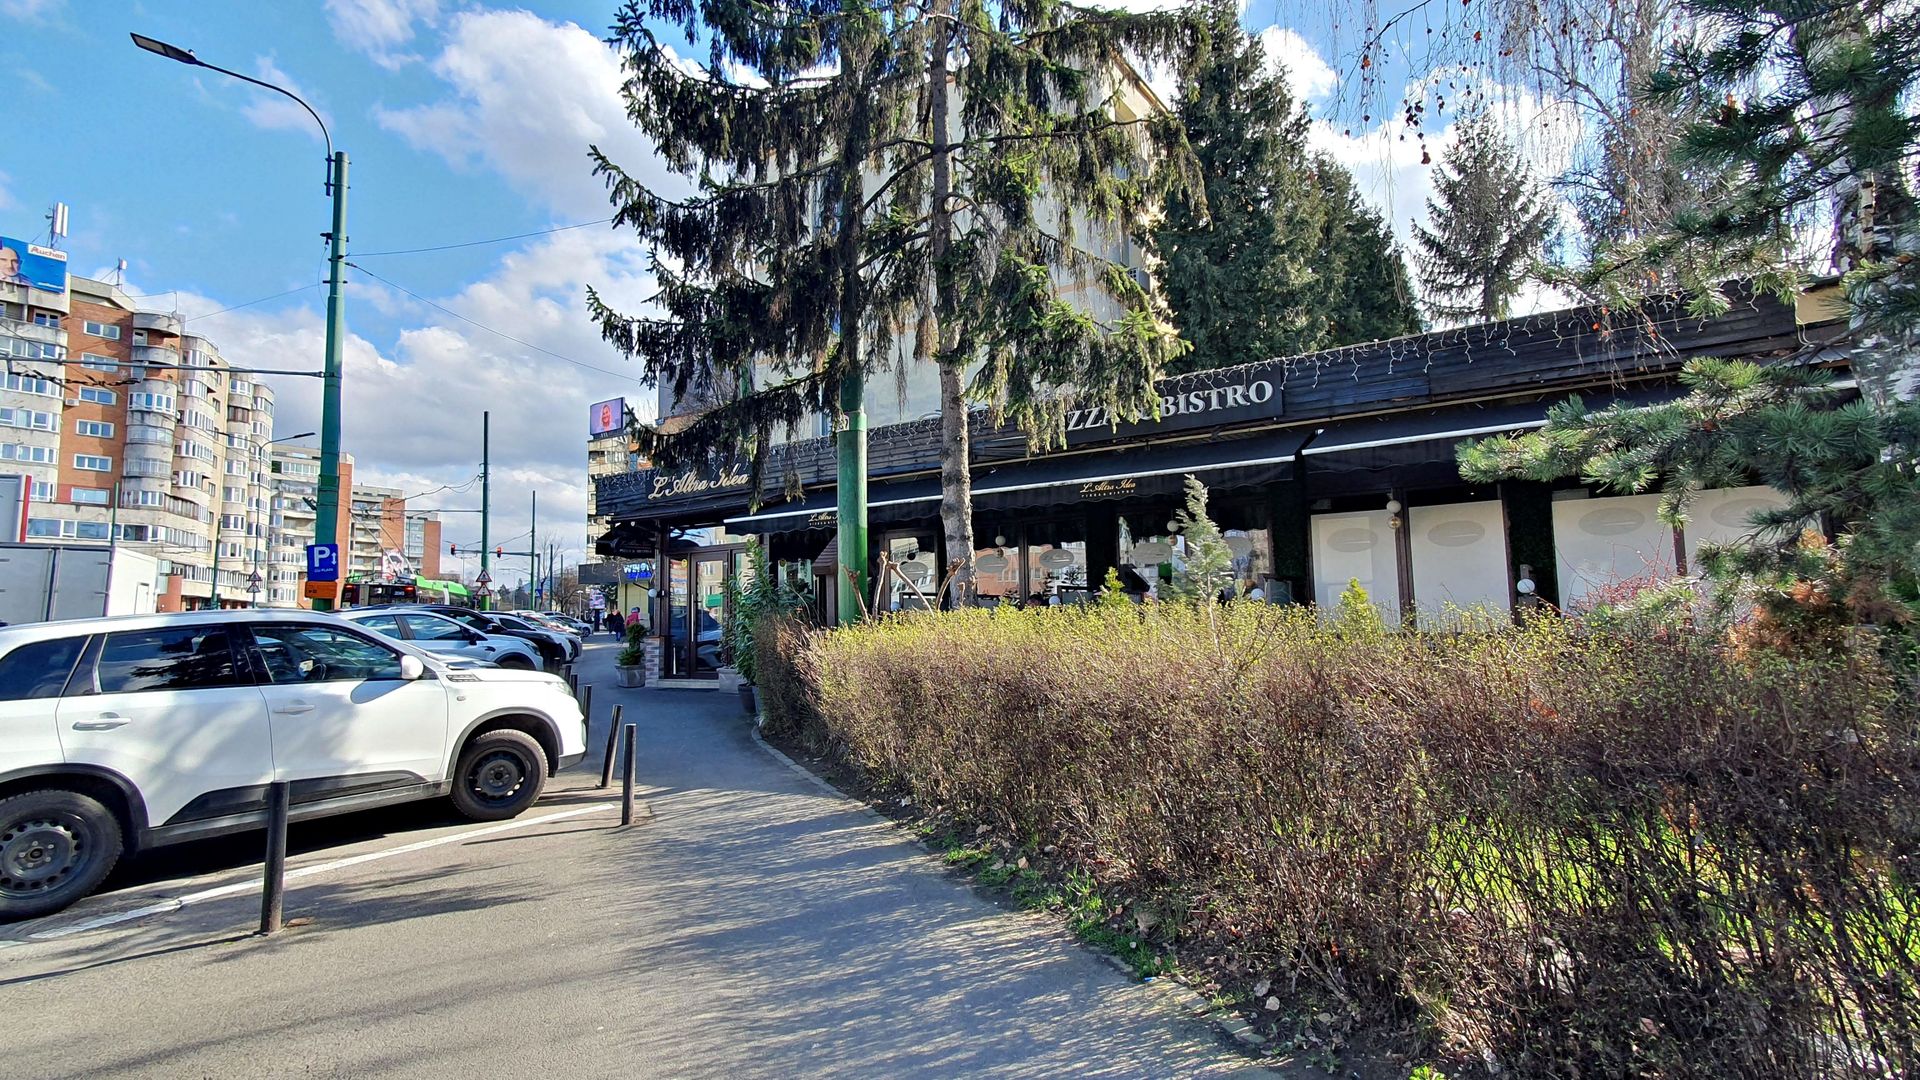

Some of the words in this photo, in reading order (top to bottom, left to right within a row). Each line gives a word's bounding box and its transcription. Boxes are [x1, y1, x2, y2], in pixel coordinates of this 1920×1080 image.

[30, 246, 66, 260] Auchan
[1159, 380, 1274, 417] BISTRO
[314, 546, 330, 567] P
